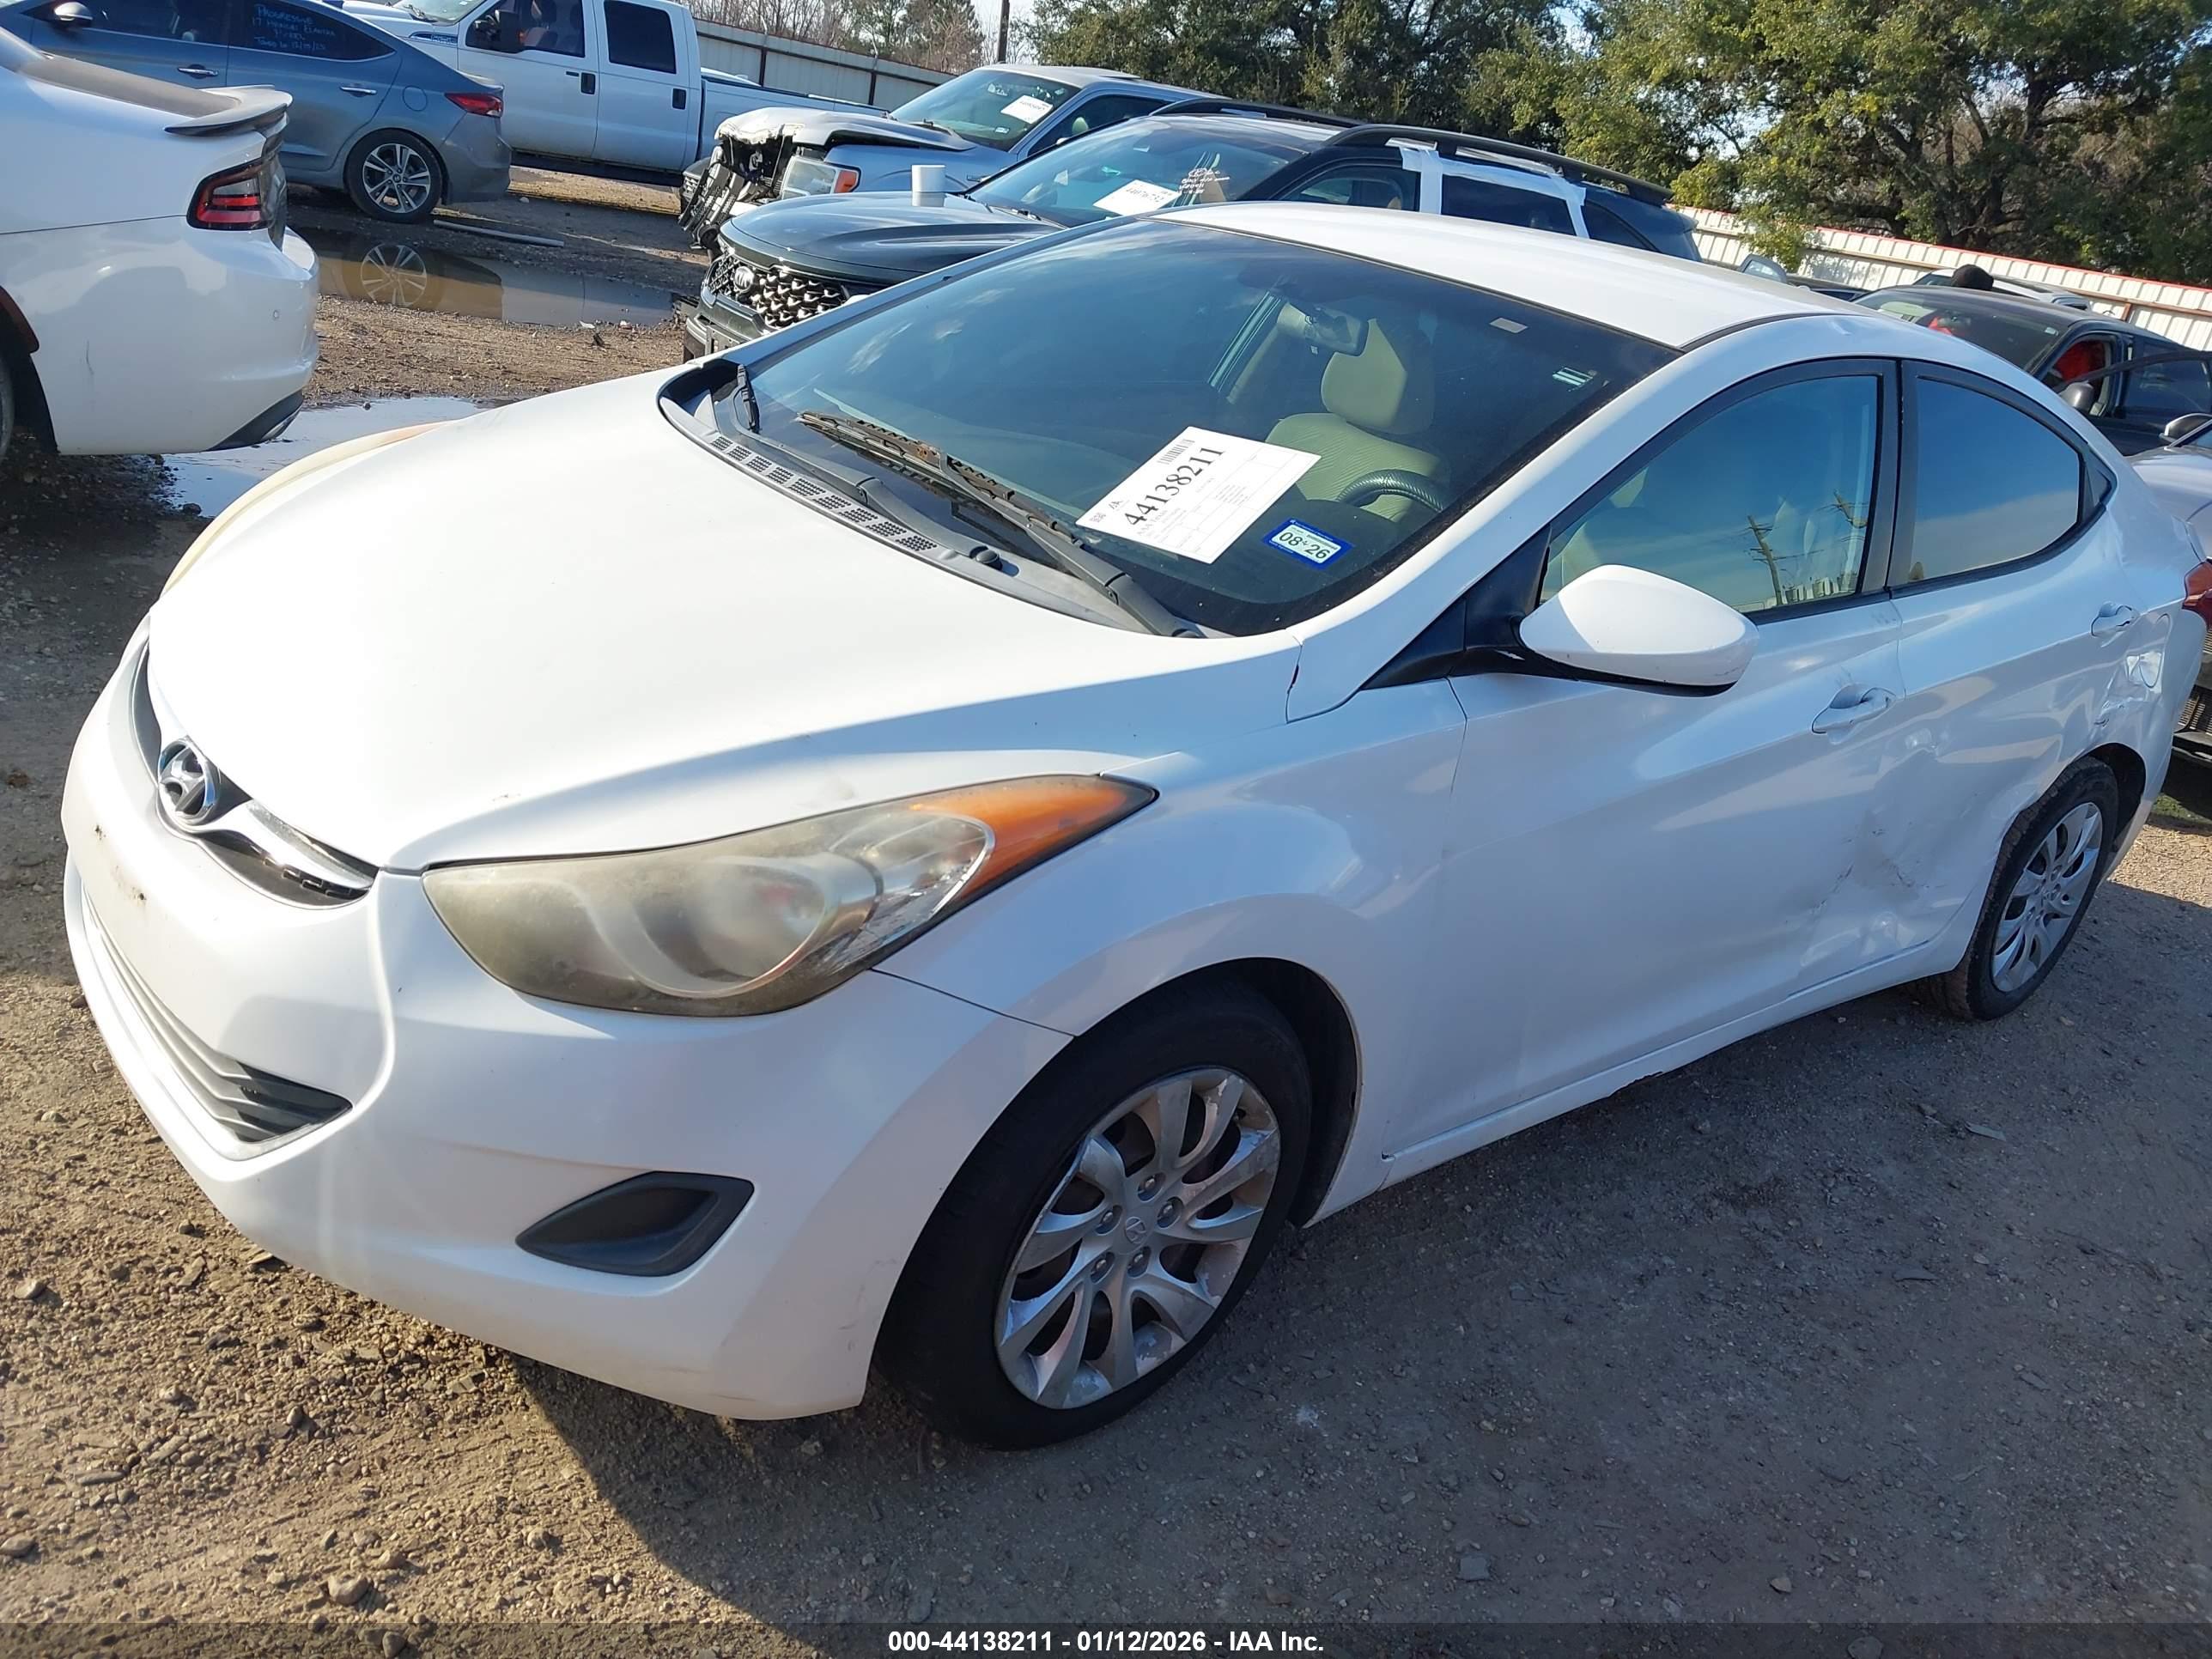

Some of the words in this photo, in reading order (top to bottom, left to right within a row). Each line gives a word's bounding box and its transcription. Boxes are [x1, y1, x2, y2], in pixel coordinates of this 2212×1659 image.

[1124, 447, 1224, 526] 44138211
[1279, 532, 1304, 546] 08
[1304, 544, 1331, 559] 26
